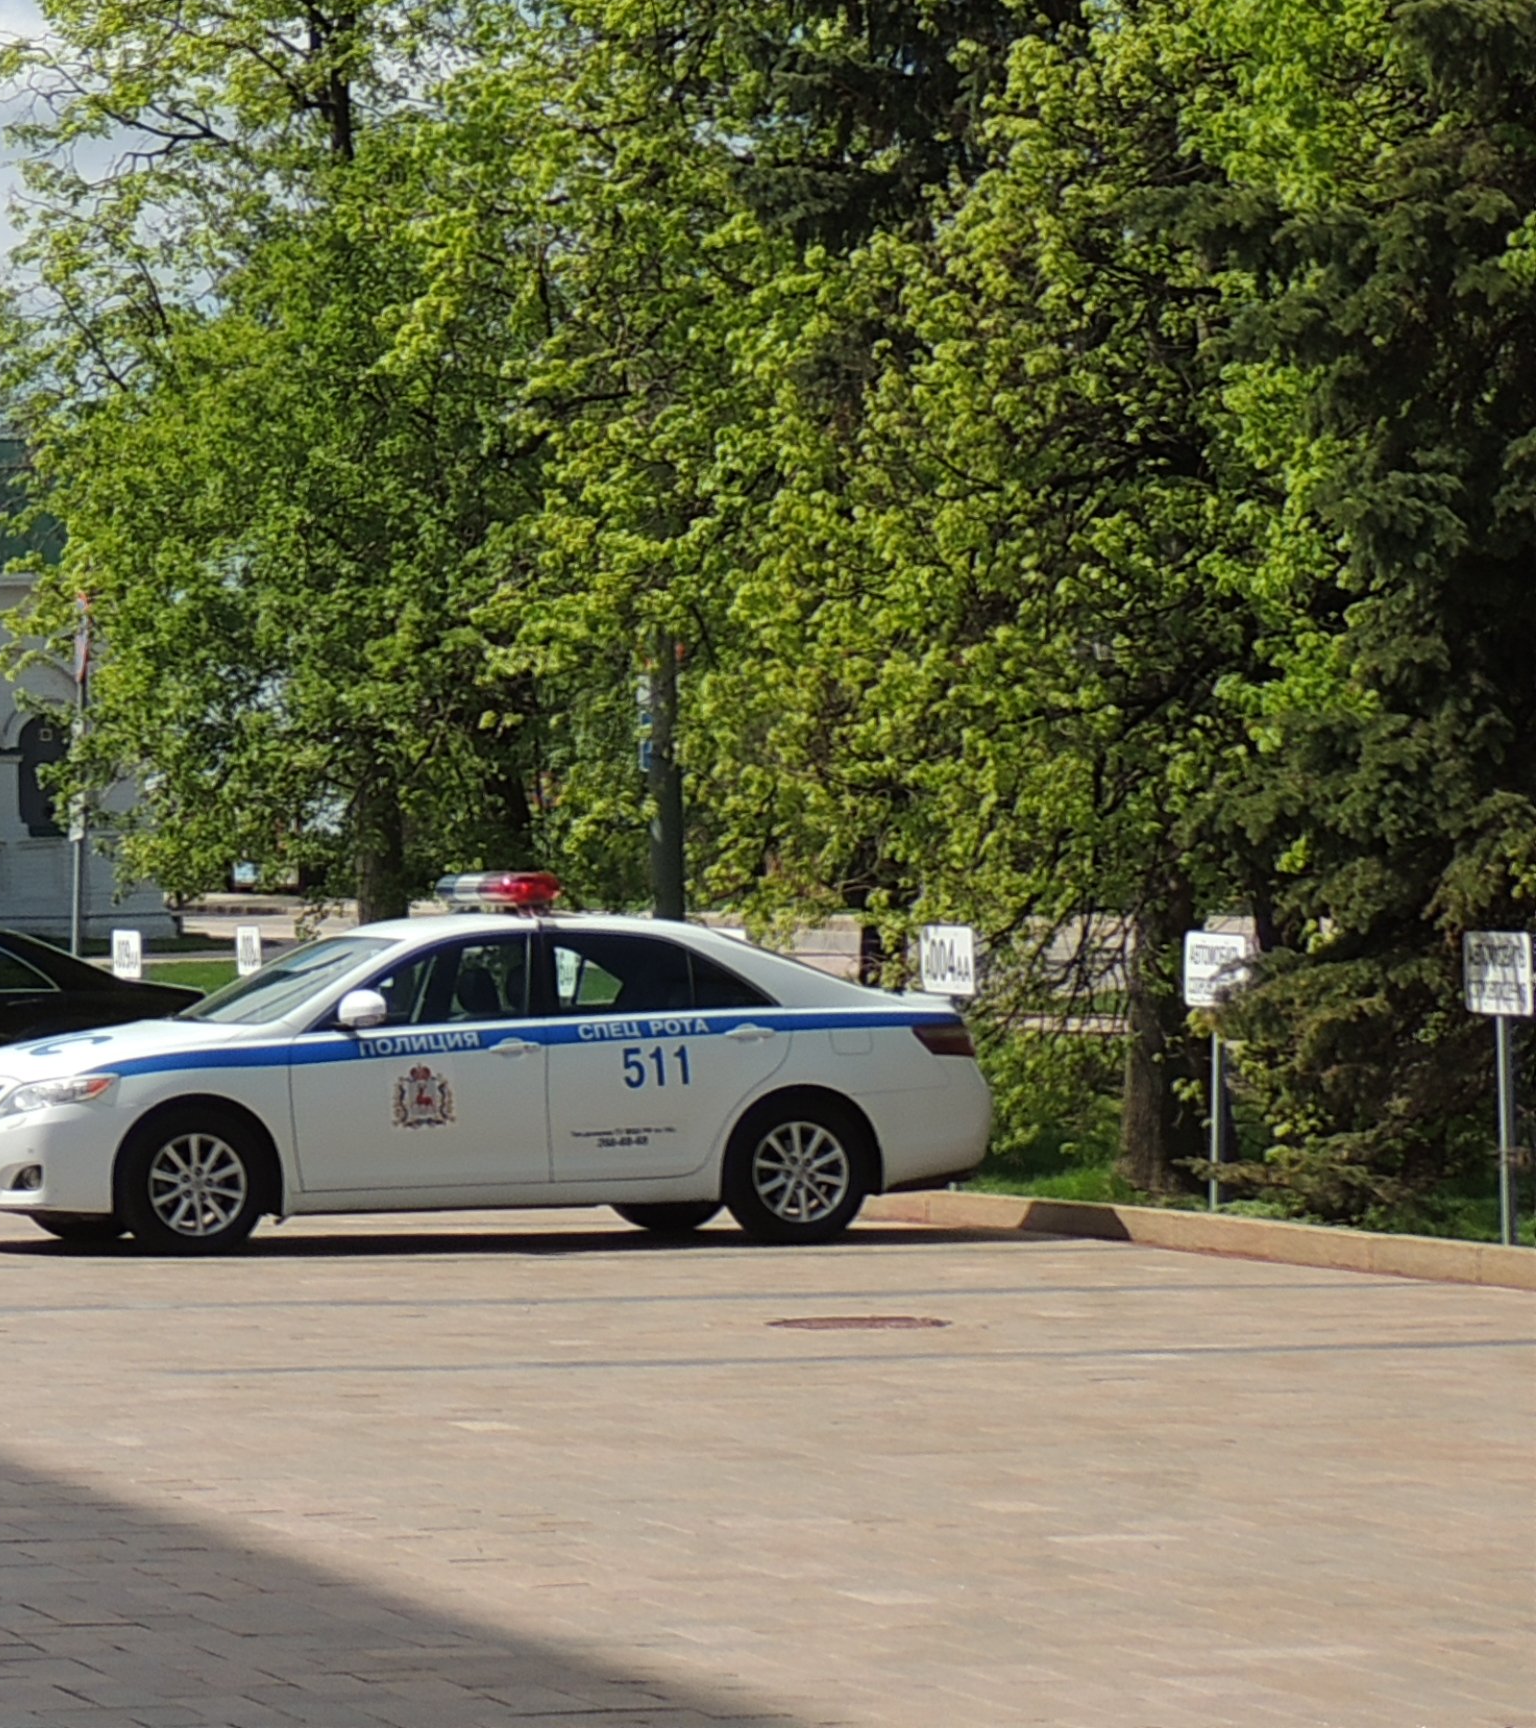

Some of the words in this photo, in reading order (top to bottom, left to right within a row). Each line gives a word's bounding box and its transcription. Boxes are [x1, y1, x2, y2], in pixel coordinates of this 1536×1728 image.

[578, 1021, 641, 1040] СПЕЦ
[651, 1018, 710, 1036] РОТА
[359, 1032, 480, 1057] ПОЛИЦИЯ
[622, 1044, 691, 1089] 511
